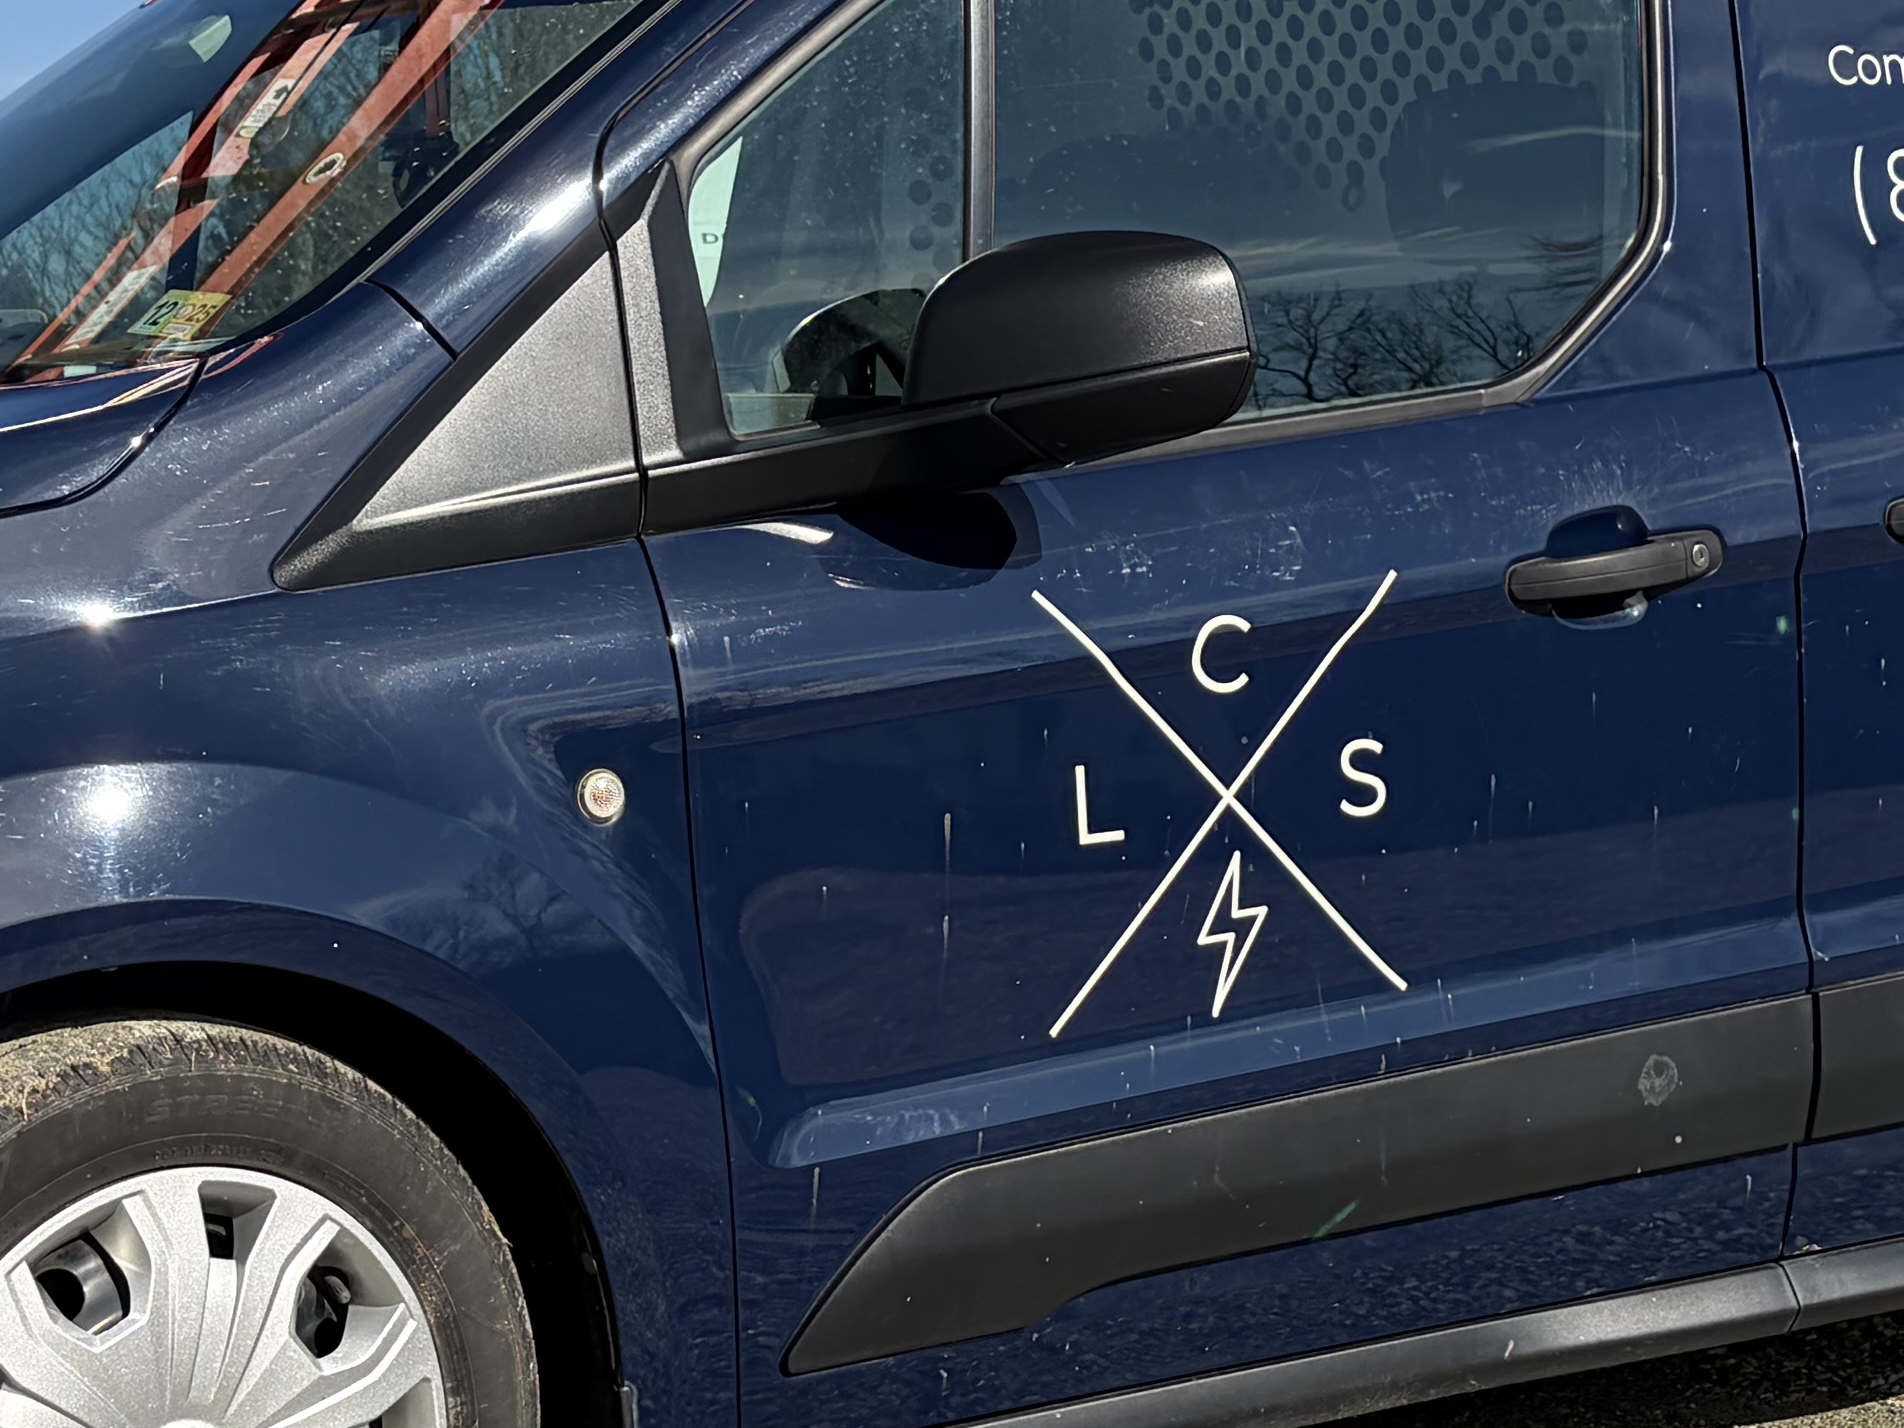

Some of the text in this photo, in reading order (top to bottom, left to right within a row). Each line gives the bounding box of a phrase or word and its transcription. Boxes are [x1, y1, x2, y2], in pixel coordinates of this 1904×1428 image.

[142, 299, 218, 326] 12 25
[1191, 614, 1252, 694] C
[1074, 738, 1387, 846] L S
